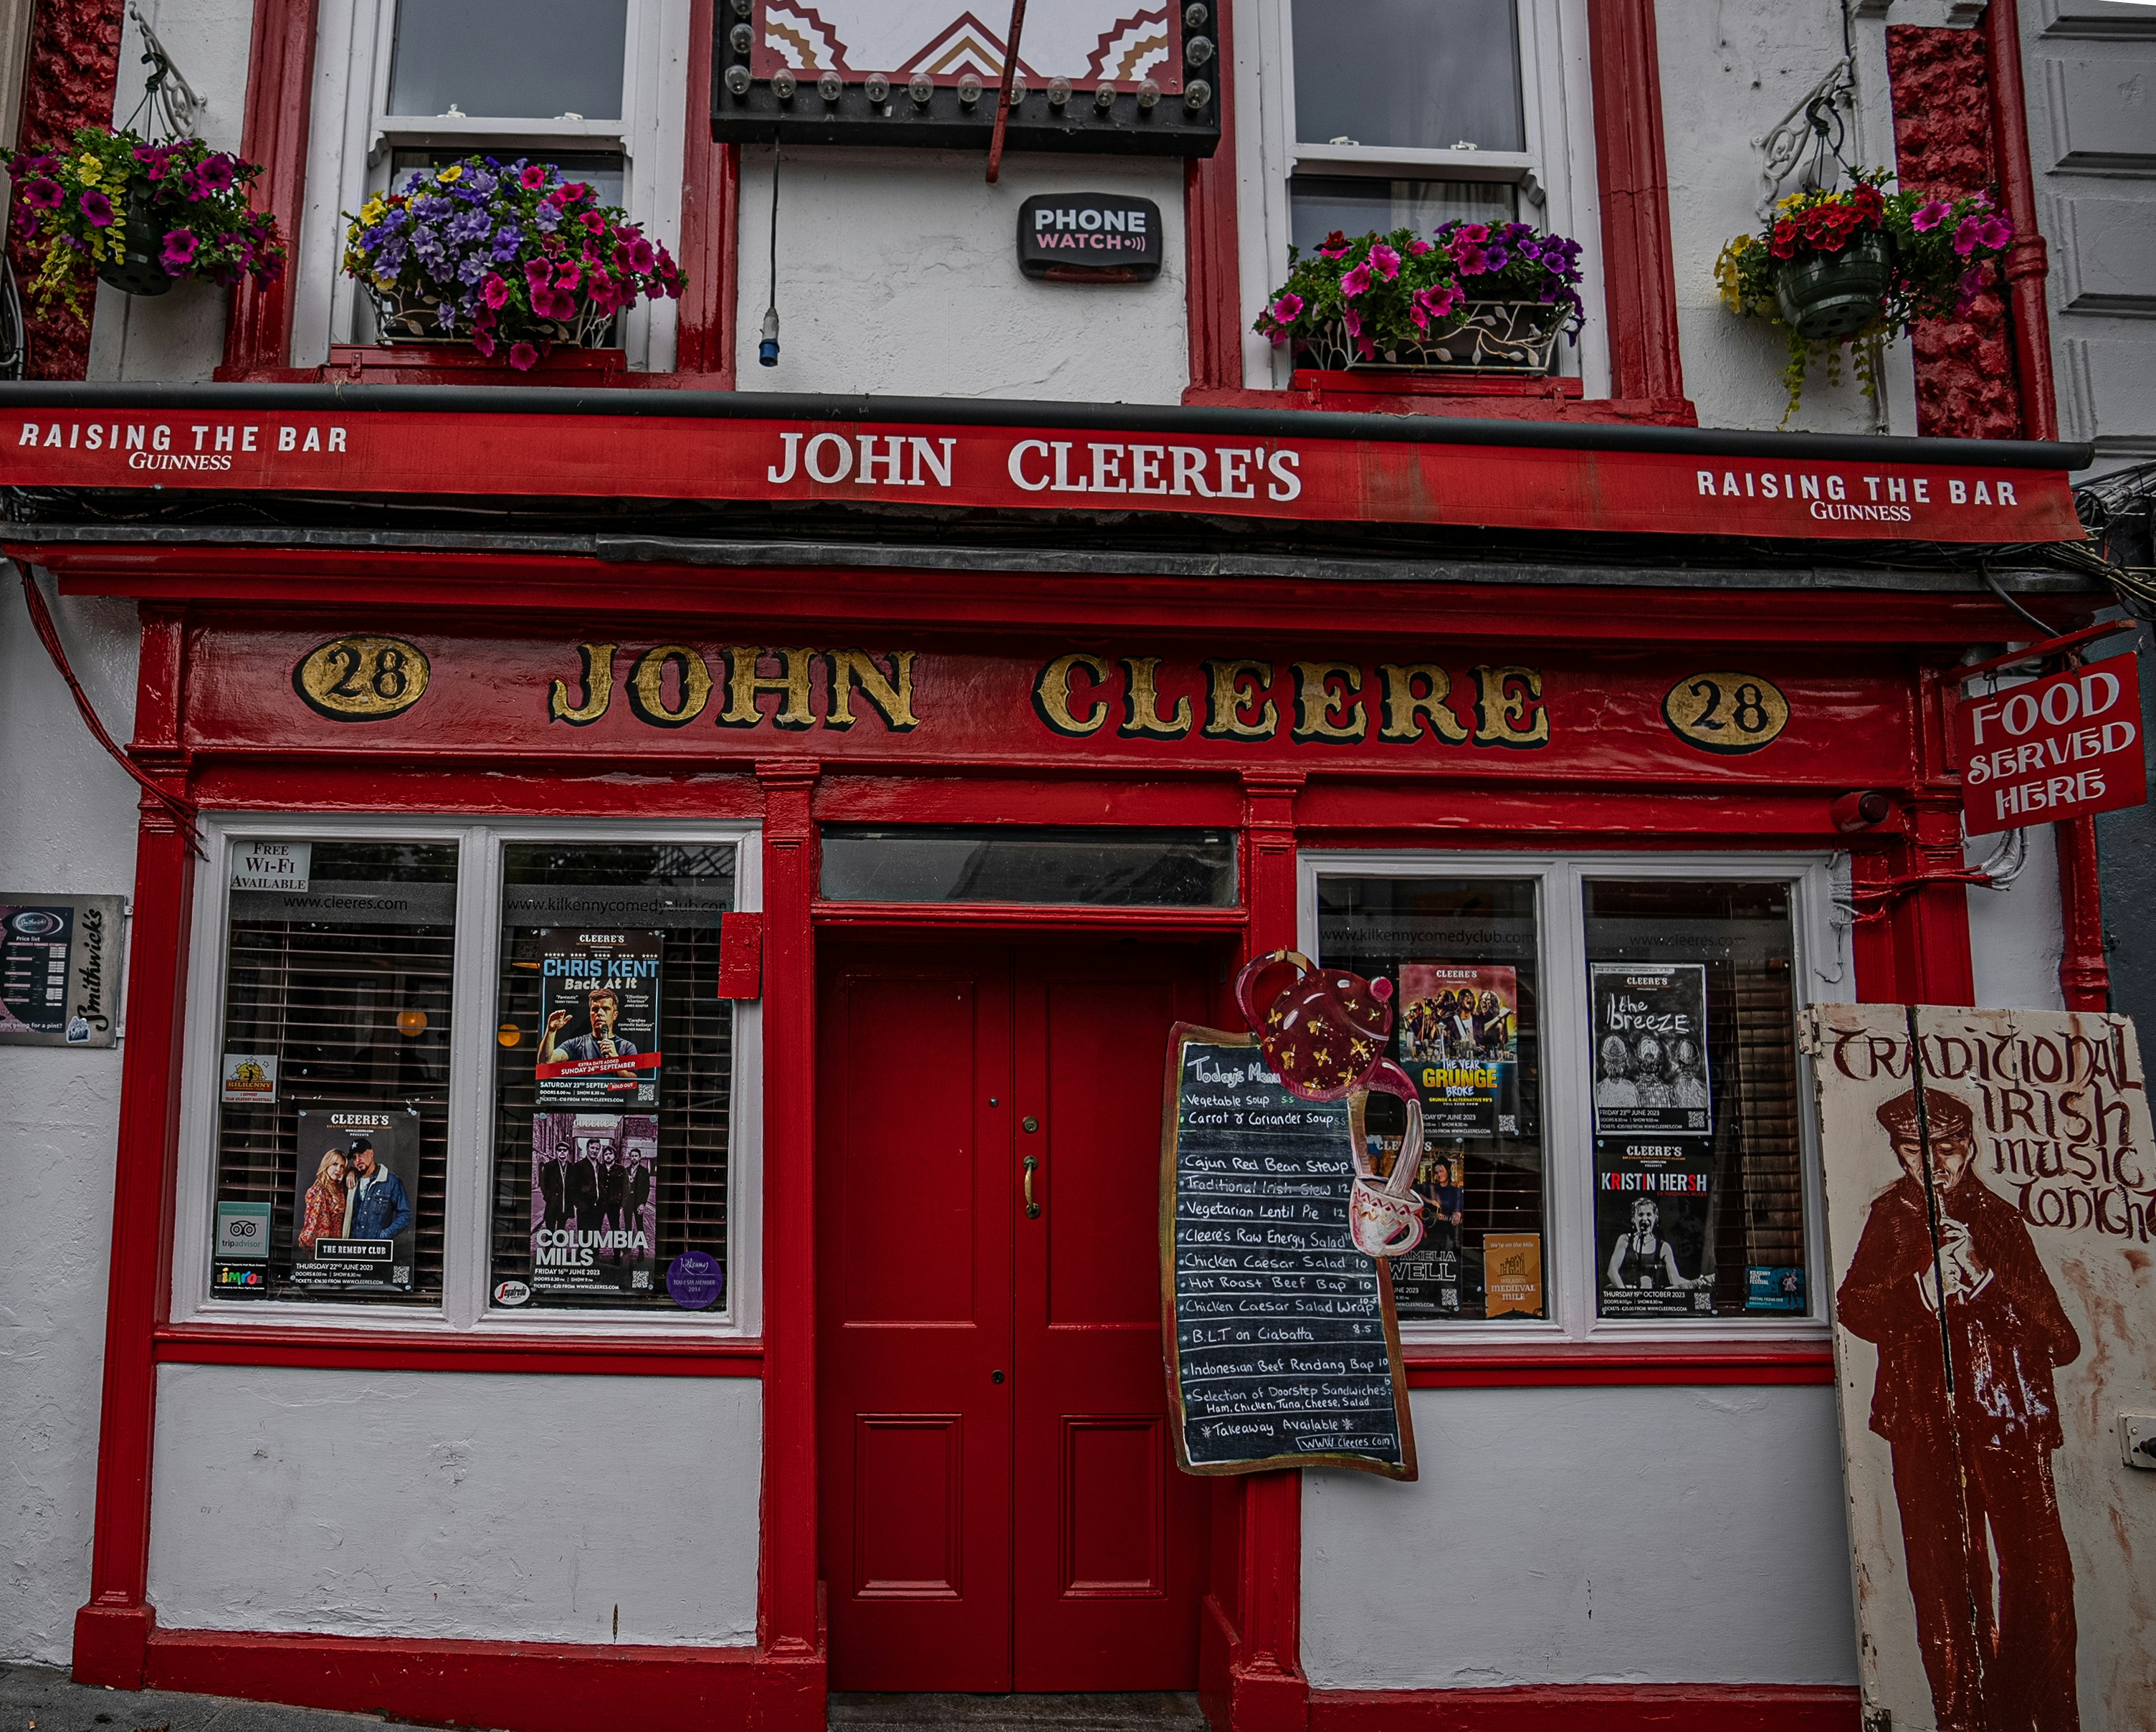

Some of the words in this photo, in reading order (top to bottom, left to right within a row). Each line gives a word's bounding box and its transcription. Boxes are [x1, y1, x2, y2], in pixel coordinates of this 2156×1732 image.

[1034, 209, 1146, 233] PHONE
[1036, 233, 1122, 250] WATCH
[19, 423, 171, 450] RAISING
[191, 424, 259, 452] THE
[278, 426, 348, 453] BAR
[128, 450, 233, 471] GUINNESS
[767, 432, 957, 487] JOHN
[1006, 439, 1302, 503] CLEERE'S
[1696, 470, 1846, 500] RAISING
[1863, 476, 1931, 503] THE
[1947, 479, 2018, 506] BAR
[1809, 500, 1912, 523] GUINNESS
[322, 647, 409, 700] 28
[548, 643, 922, 734] JOHN
[1031, 652, 1552, 751] CLEERE
[1688, 679, 1773, 735] 28
[1972, 672, 2120, 746] FOOD
[1967, 720, 2137, 786] SERVED
[1995, 767, 2107, 821] HERE
[282, 895, 409, 911] www.cleeres.com
[578, 934, 625, 943] CLEERE'S
[1320, 927, 1536, 946] www.kilkennycomedyclub.com
[77, 908, 109, 1032] Smithwick's
[543, 958, 603, 977] CHRIS
[608, 959, 660, 978] KENT
[1436, 969, 1478, 979] CLEERE'S
[564, 978, 601, 991] Back
[603, 978, 622, 990] At
[625, 978, 637, 989] It
[1626, 977, 1668, 986] CLEERE'S
[1619, 994, 1649, 1014] the
[561, 1067, 587, 1075] SUNDAY
[600, 1061, 636, 1072] SEPTEMBER
[1186, 1055, 1244, 1089] Today's
[1248, 1062, 1282, 1084] Menu
[1441, 1059, 1457, 1072] THE
[1459, 1059, 1482, 1072] YEAR
[1422, 1067, 1499, 1088] GRUNGE
[1186, 1094, 1241, 1108] Vegetable
[1445, 1086, 1475, 1099] BROKE
[330, 1113, 389, 1126] CLEERE'S
[1188, 1111, 1229, 1125] Carrot
[1248, 1113, 1302, 1126] Coriander
[1306, 1113, 1335, 1128] Soup
[1626, 1146, 1682, 1157] CLEERE'S
[1184, 1154, 1227, 1171] Cajun
[1232, 1157, 1259, 1171] Red
[1264, 1157, 1302, 1172] Bean
[1184, 1176, 1256, 1194] Traditional
[1262, 1181, 1292, 1195] Irish
[1337, 1184, 1350, 1193] 12
[1601, 1173, 1656, 1191] KRISTIN
[1659, 1173, 1707, 1192] HERSH
[1186, 1201, 1254, 1221] Vegetarian
[1259, 1204, 1294, 1219] Lentil
[1302, 1205, 1320, 1219] Pie
[1333, 1207, 1346, 1218] 12
[222, 1239, 261, 1249] tripadvisor
[536, 1229, 649, 1249] COLUMBIA
[1186, 1228, 1231, 1243] Cleere's
[1236, 1228, 1262, 1244] Raw
[1267, 1229, 1307, 1251] Energy
[1310, 1231, 1346, 1249] Salad
[322, 1245, 337, 1254] THE
[338, 1245, 367, 1255] REMEDY
[368, 1246, 386, 1255] CLUB
[535, 1247, 594, 1267] MILLS
[1184, 1254, 1237, 1269] Chicken
[1244, 1255, 1295, 1270] Caesar
[1302, 1255, 1346, 1270] Salad
[1355, 1258, 1368, 1269] 10
[221, 1267, 258, 1285] imro
[1188, 1277, 1214, 1290] Hot
[1219, 1277, 1263, 1290] Roast
[1272, 1277, 1306, 1290] Beef
[1316, 1280, 1347, 1293] Bap
[1358, 1280, 1372, 1290] 10
[1186, 1298, 1234, 1313] Chicken
[1239, 1299, 1290, 1313] Caesar
[1294, 1298, 1333, 1313] Salad
[1337, 1301, 1375, 1317] Wrap
[1236, 1331, 1251, 1341] on
[1257, 1327, 1315, 1341] Ciabatta
[1353, 1324, 1372, 1334] 8.5
[1190, 1362, 1254, 1376] Indonesian
[1257, 1359, 1286, 1374] Beef
[1290, 1359, 1347, 1376] Rendang
[1350, 1358, 1375, 1372] Bap
[1378, 1358, 1389, 1367] 10
[1192, 1388, 1247, 1402] Selection
[1251, 1385, 1265, 1399] of
[1267, 1384, 1319, 1398] Doorstep
[1206, 1403, 1233, 1414] Ham,
[1234, 1401, 1277, 1413] Chicken,
[1277, 1399, 1304, 1411] Tuna,
[1304, 1397, 1341, 1409] Cheese,
[1213, 1419, 1275, 1437] Takeaway
[1282, 1419, 1339, 1432] Available
